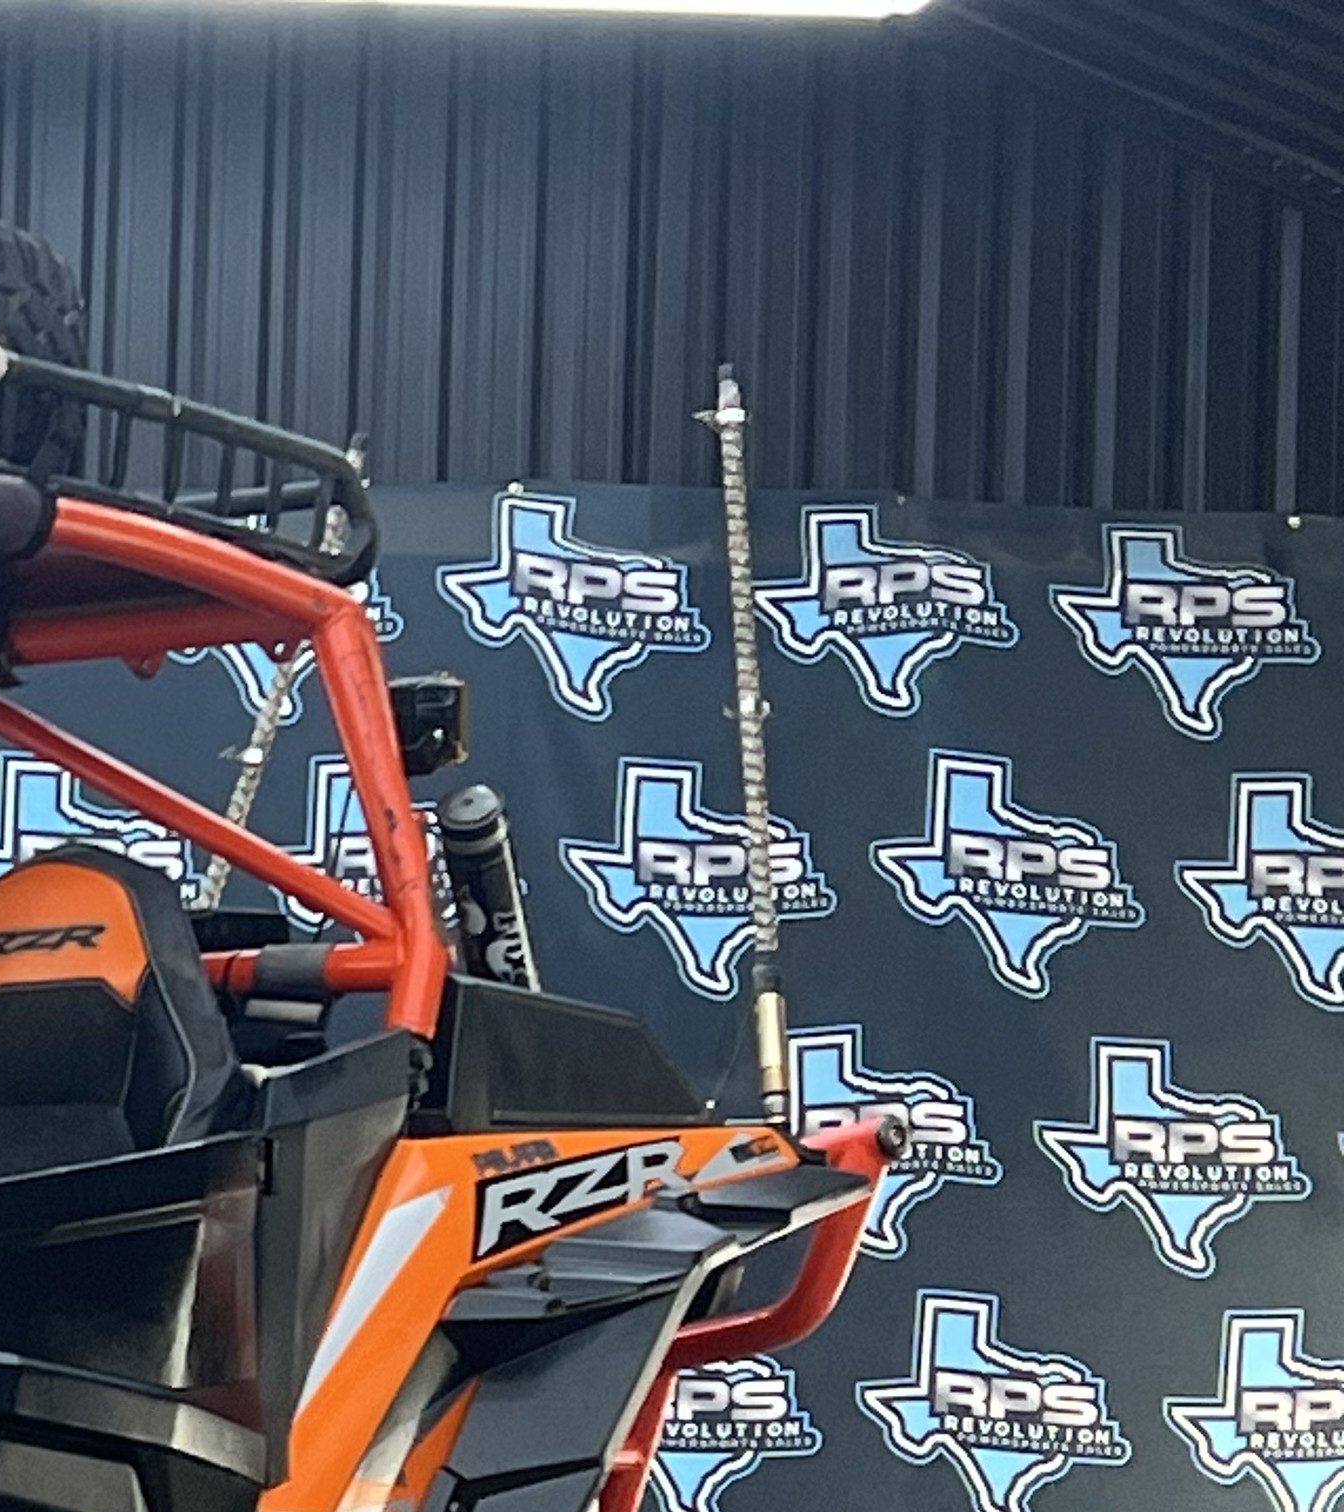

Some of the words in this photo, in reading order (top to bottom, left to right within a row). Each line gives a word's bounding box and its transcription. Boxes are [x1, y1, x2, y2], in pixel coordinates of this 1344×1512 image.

[514, 550, 679, 616] RPS
[825, 565, 984, 611] RPS
[523, 596, 690, 631] REVOLUTION
[835, 601, 996, 626] REVOLUTION
[1126, 583, 1286, 628] RPS
[1136, 626, 1298, 642] REVOLUTION
[948, 833, 1110, 892] RPS
[1251, 854, 1344, 897] RP
[649, 883, 815, 902] REVOLUION
[960, 877, 1123, 907] REVOLUTION
[1113, 1120, 1274, 1165] RPS
[1125, 1163, 1288, 1179] REVOLUTION
[477, 1140, 693, 1257] RZR
[665, 1379, 788, 1420] PS
[934, 1371, 1097, 1429] RPS
[1241, 1389, 1344, 1432] RP
[666, 1421, 800, 1438] VOLUTION
[945, 1415, 1110, 1444] REVOLUTION
[1250, 1430, 1344, 1449] REVOLU
